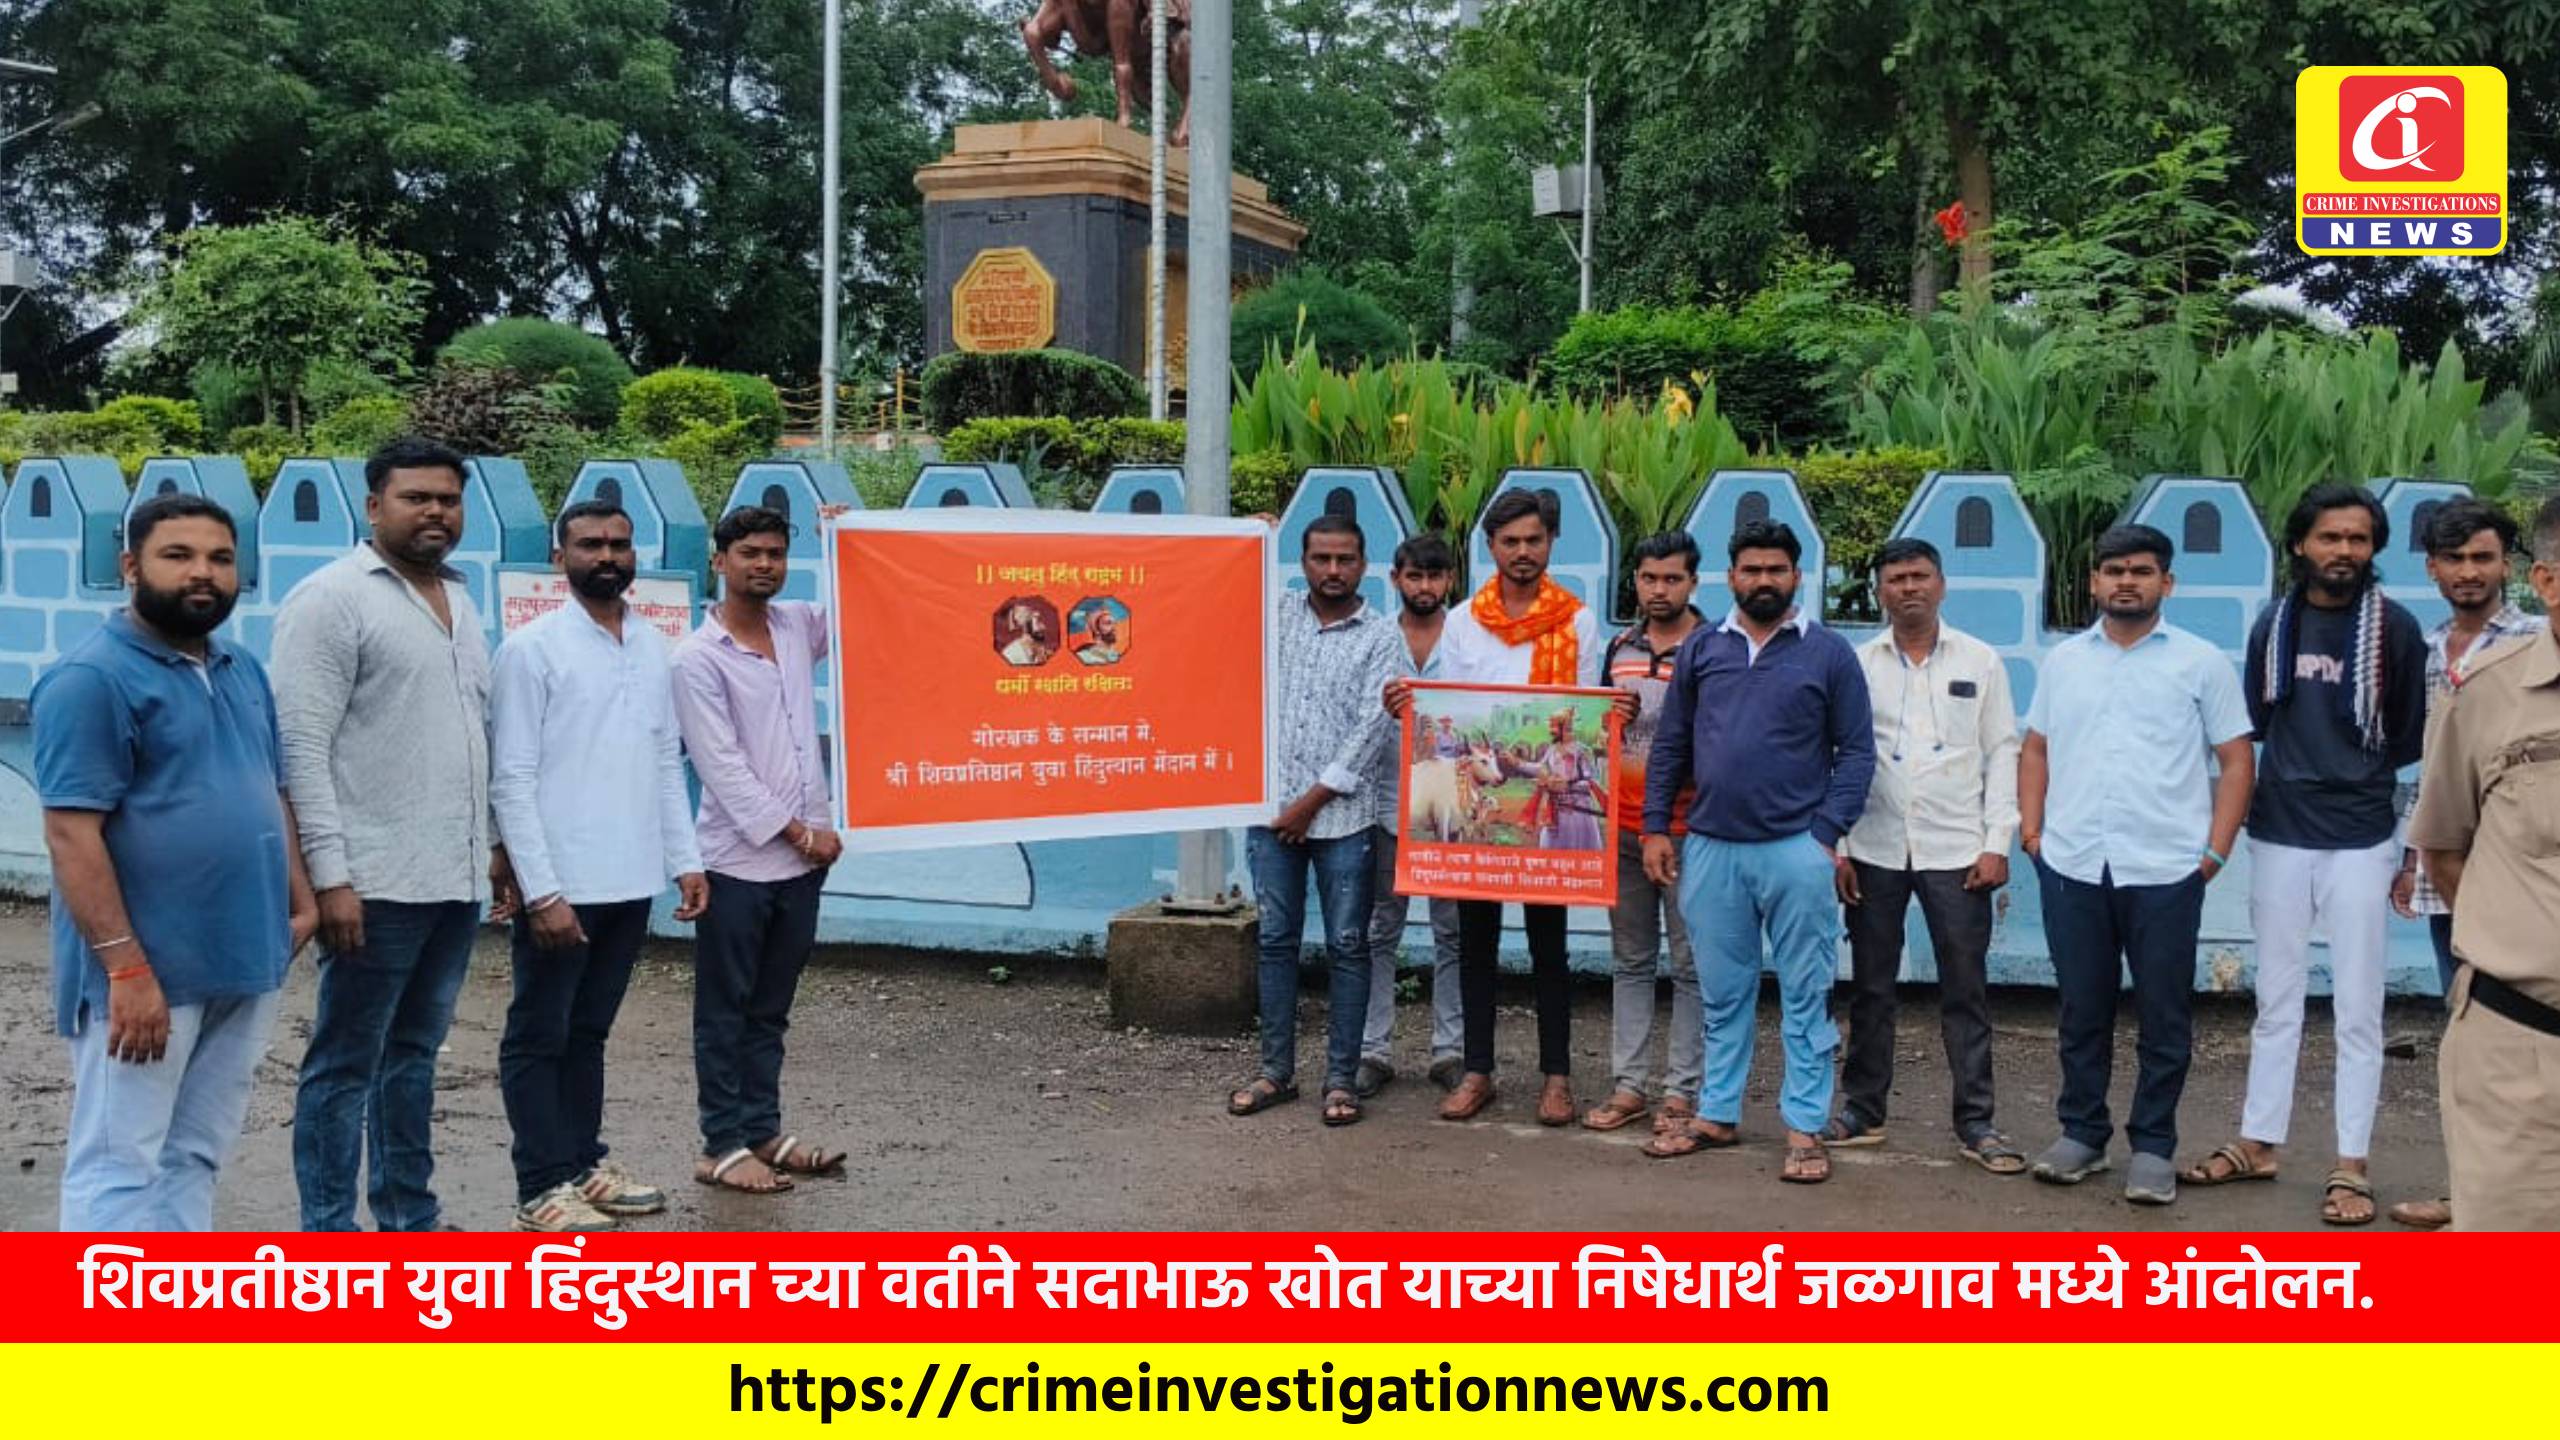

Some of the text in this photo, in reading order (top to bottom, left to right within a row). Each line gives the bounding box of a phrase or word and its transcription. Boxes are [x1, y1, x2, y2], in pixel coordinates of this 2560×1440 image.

[972, 722, 1040, 747] गोरक्षक
[1047, 721, 1065, 745] के
[885, 761, 908, 786] श्री
[918, 757, 1024, 785] शिवप्रतिष्ठान
[1030, 761, 1067, 787] युवा
